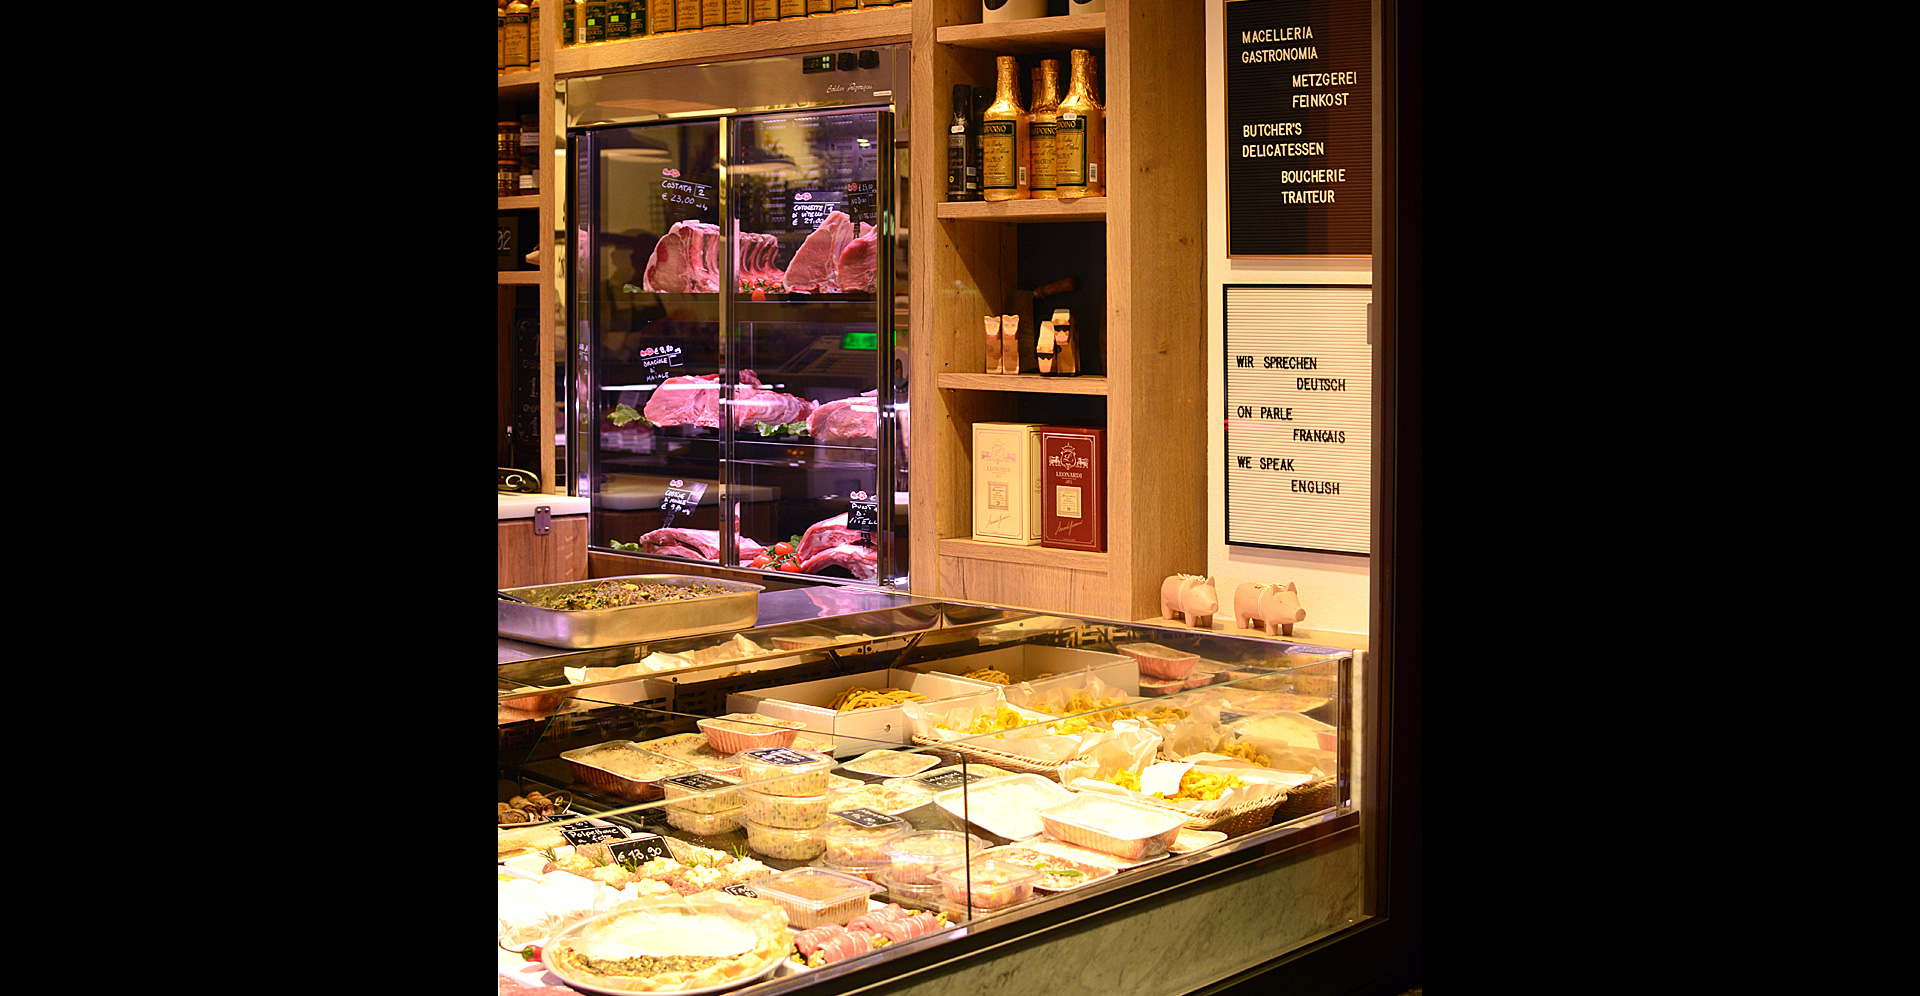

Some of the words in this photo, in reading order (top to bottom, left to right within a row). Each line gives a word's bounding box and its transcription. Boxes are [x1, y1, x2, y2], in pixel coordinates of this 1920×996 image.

[1242, 26, 1313, 43] MACELLERIA
[1241, 47, 1318, 63] GASTRONOMIA
[1292, 71, 1357, 87] METZGEREI
[1292, 93, 1349, 108] FEINKOST
[1243, 123, 1302, 138] BUTCHER'S
[1242, 142, 1324, 157] DELICATESSEN
[1281, 169, 1346, 183] BOUCHERIE
[662, 180, 692, 193] COSTATA
[662, 192, 668, 200] €
[670, 194, 695, 204] 23,00
[1281, 190, 1335, 204] TRAITEUR
[1236, 355, 1254, 368] WIR
[1263, 356, 1317, 370] SPRECHEN
[1297, 377, 1346, 391] DEUTSCH
[1237, 406, 1252, 418] ON
[1260, 407, 1293, 420] PARLE
[1293, 429, 1345, 443] FRANÇAIS
[1237, 456, 1252, 469] WE
[1260, 457, 1295, 471] SPEAK
[1291, 479, 1340, 494] ENGLISH
